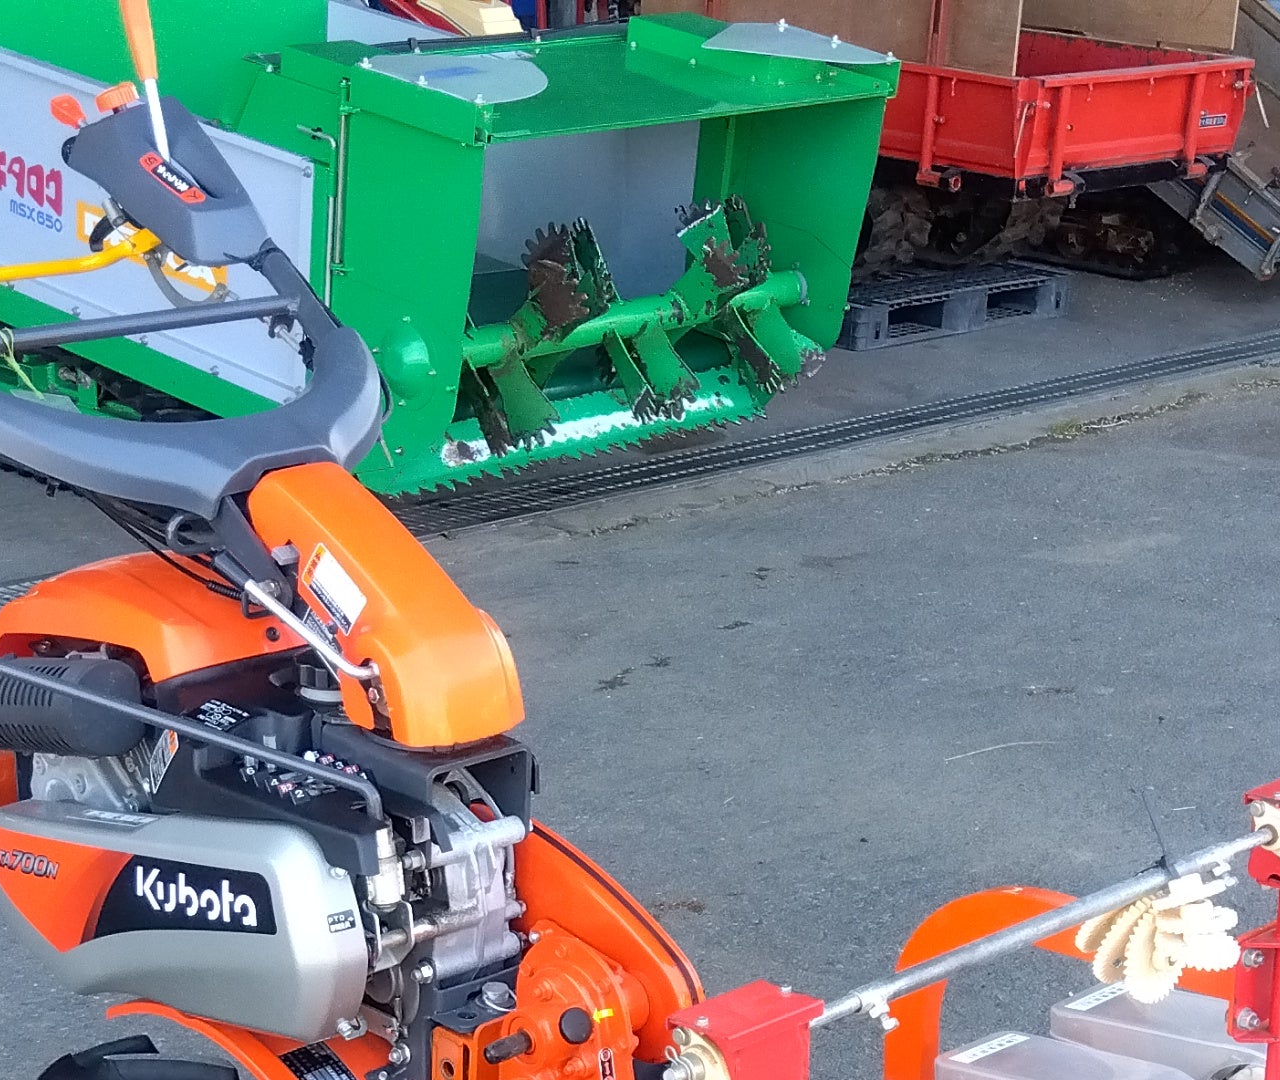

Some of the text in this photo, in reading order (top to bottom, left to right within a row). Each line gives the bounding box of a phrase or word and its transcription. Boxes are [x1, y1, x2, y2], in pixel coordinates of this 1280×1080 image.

[246, 767, 255, 775] 6
[294, 789, 304, 798] 2
[136, 865, 257, 926] Kubota
